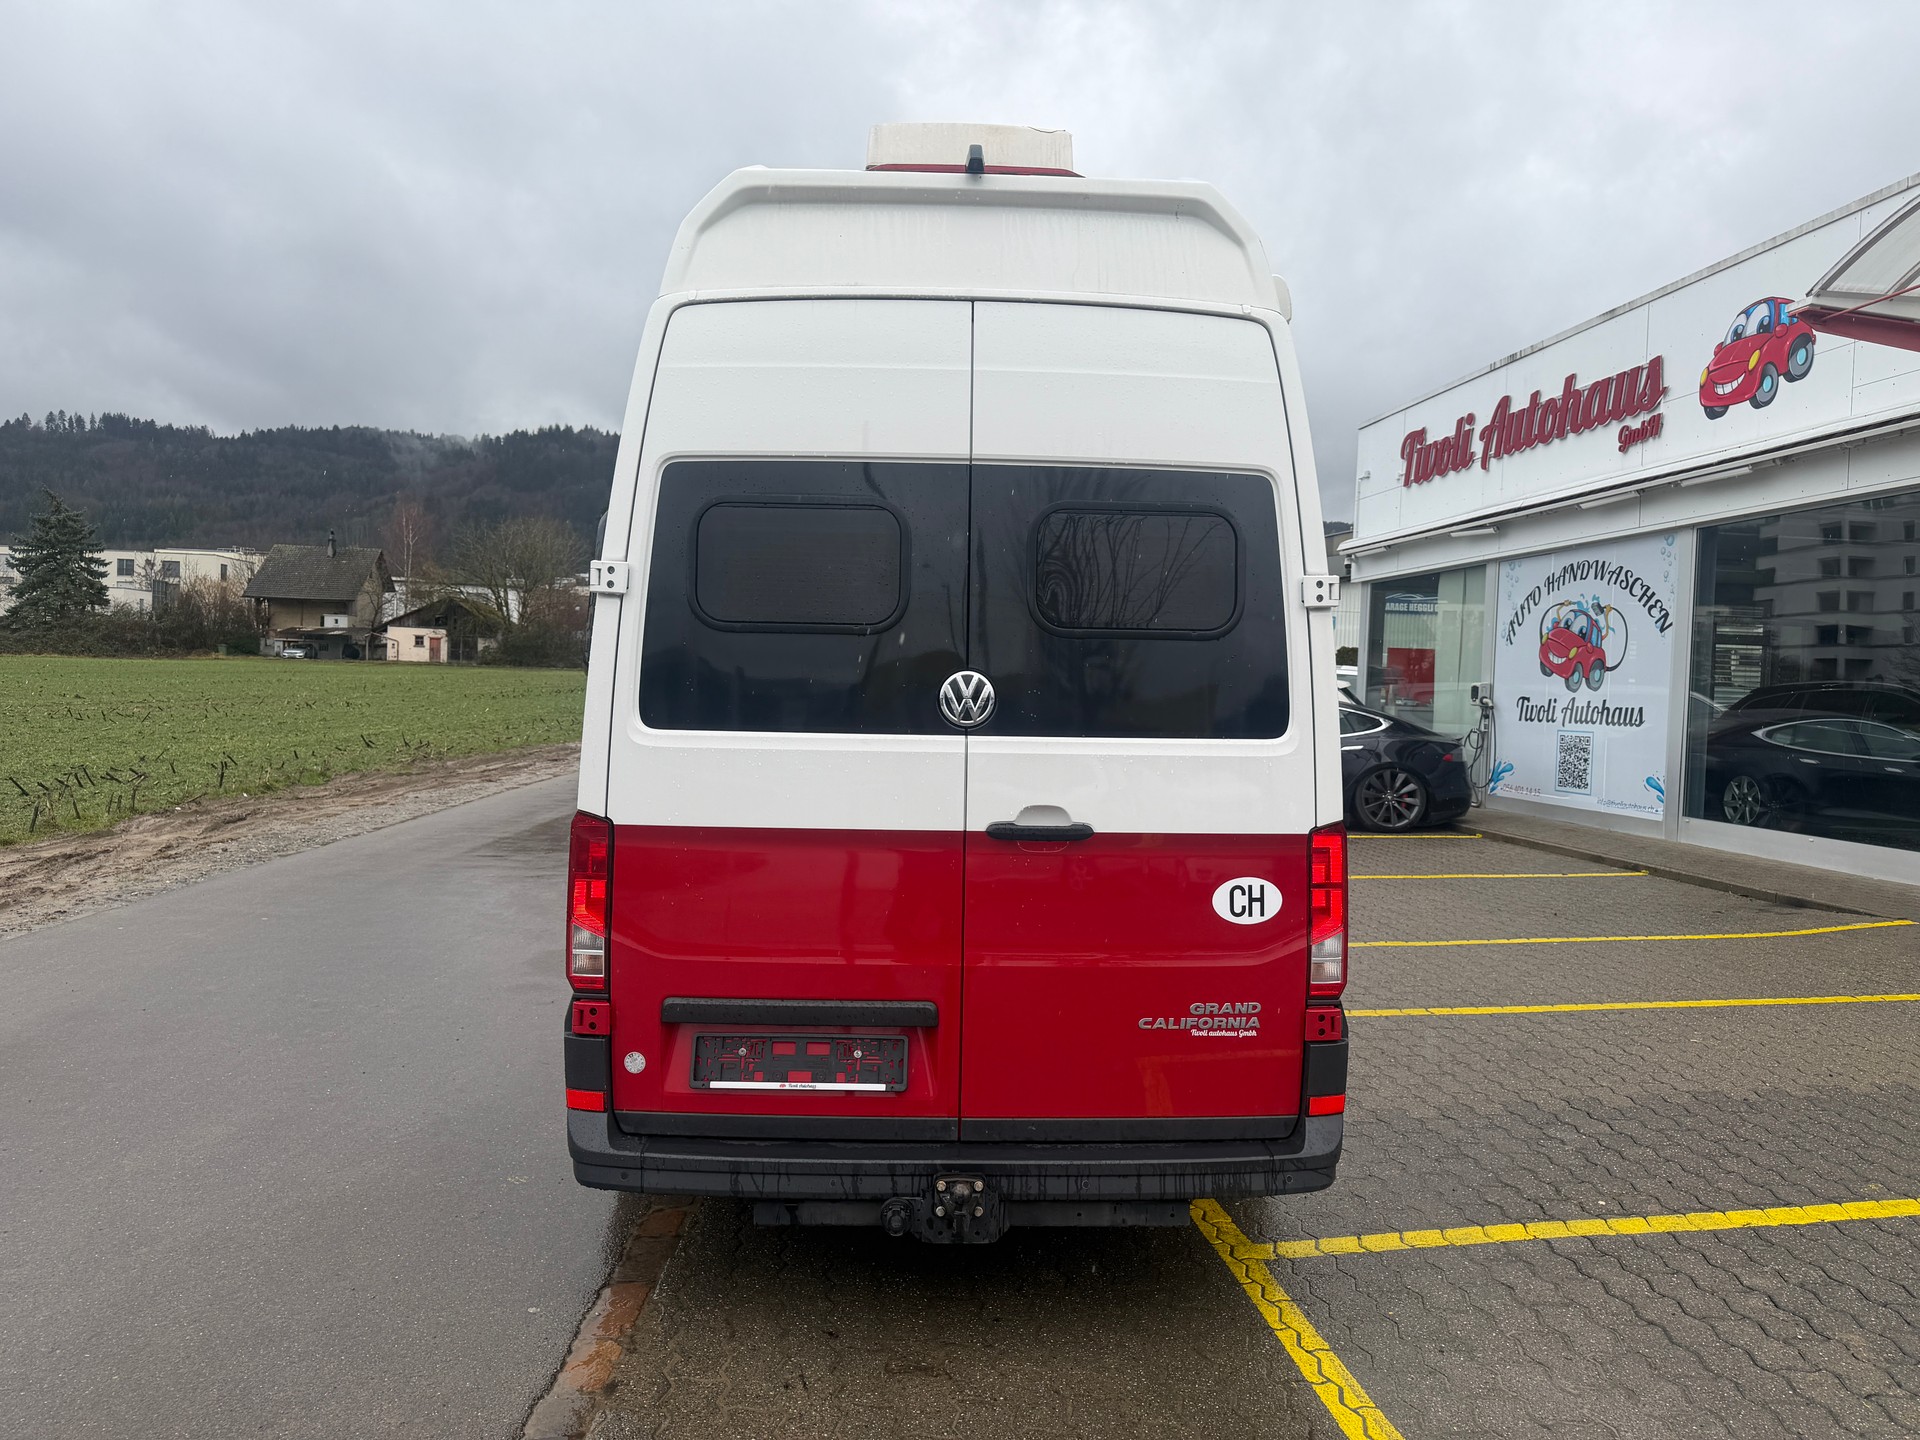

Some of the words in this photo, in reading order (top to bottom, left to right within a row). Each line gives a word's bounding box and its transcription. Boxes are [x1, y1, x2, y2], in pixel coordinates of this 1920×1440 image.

[1401, 413, 1476, 487] Tivoli
[1479, 355, 1668, 471] Autohaus
[1618, 412, 1664, 453] GmbH
[1506, 586, 1542, 645] AUTO
[1544, 560, 1673, 634] HANDWASCHEN
[940, 671, 995, 726] VW
[1516, 696, 1558, 724] Tivoli
[1561, 697, 1645, 728] Autohaus
[1229, 885, 1265, 917] CH
[1138, 1016, 1260, 1030] CALIFORNIA
[1190, 1002, 1261, 1015] GRAND
[1238, 1029, 1257, 1038] Gmbh
